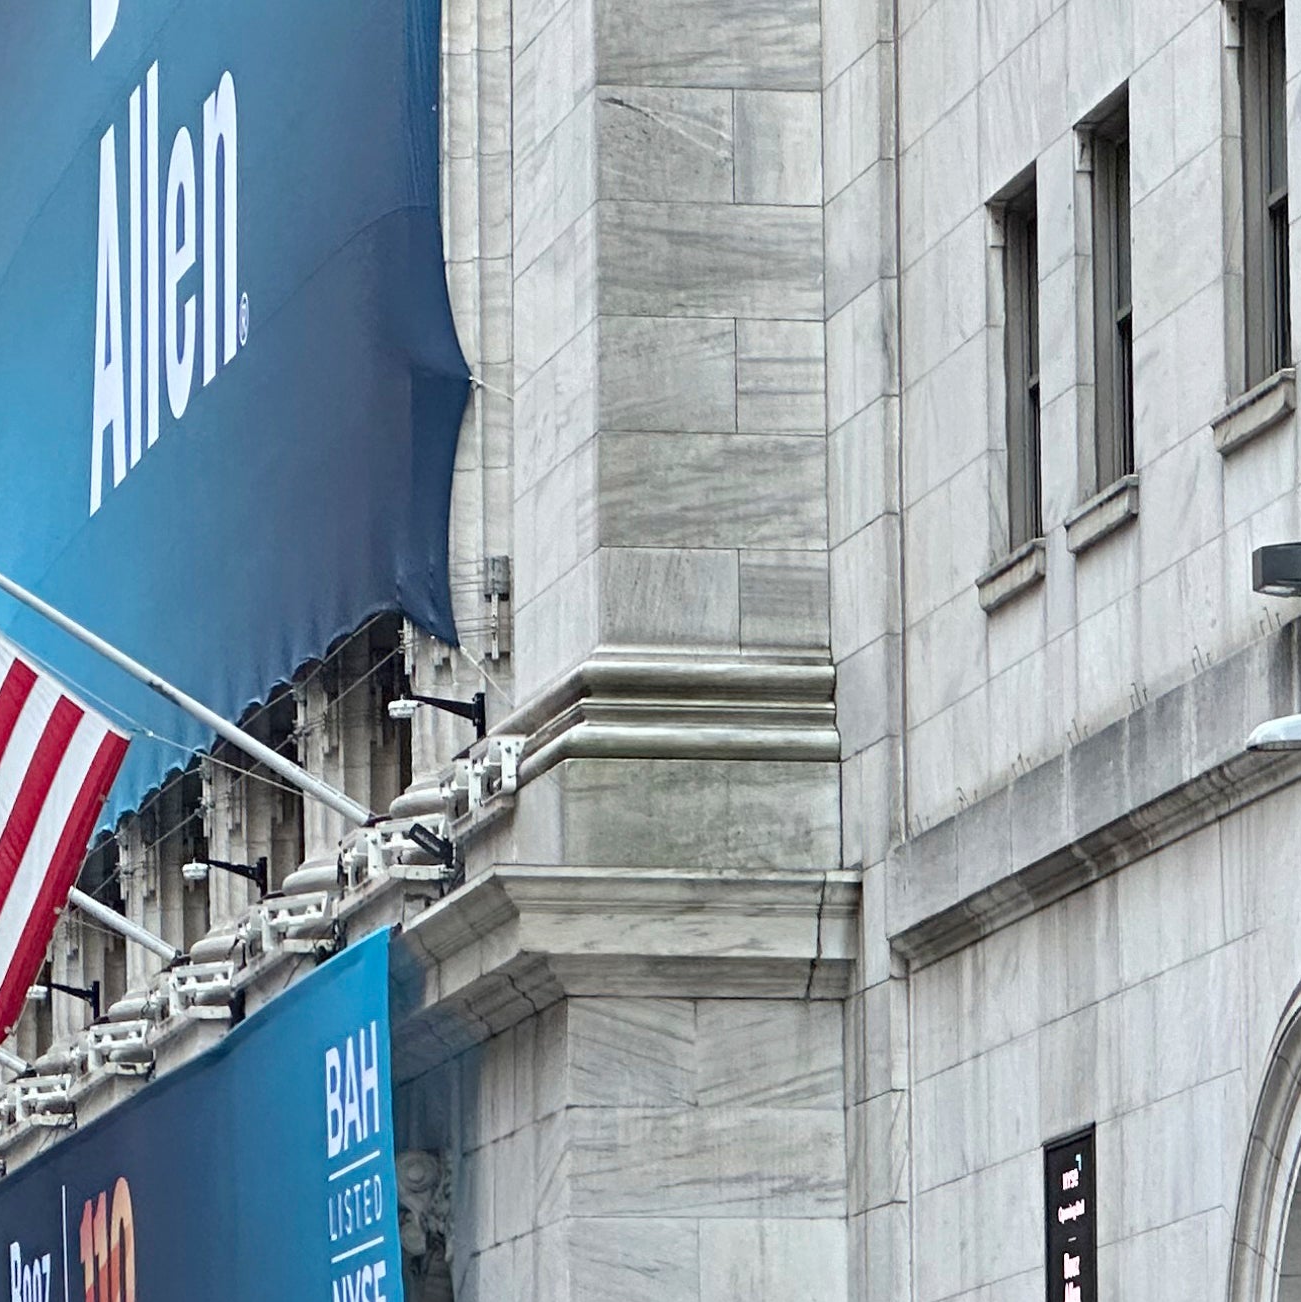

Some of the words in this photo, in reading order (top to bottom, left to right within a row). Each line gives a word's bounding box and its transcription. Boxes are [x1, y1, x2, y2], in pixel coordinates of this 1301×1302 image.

[89, 60, 238, 518] Allen
[326, 1021, 380, 1159] BAH
[328, 1175, 383, 1241] LISTED
